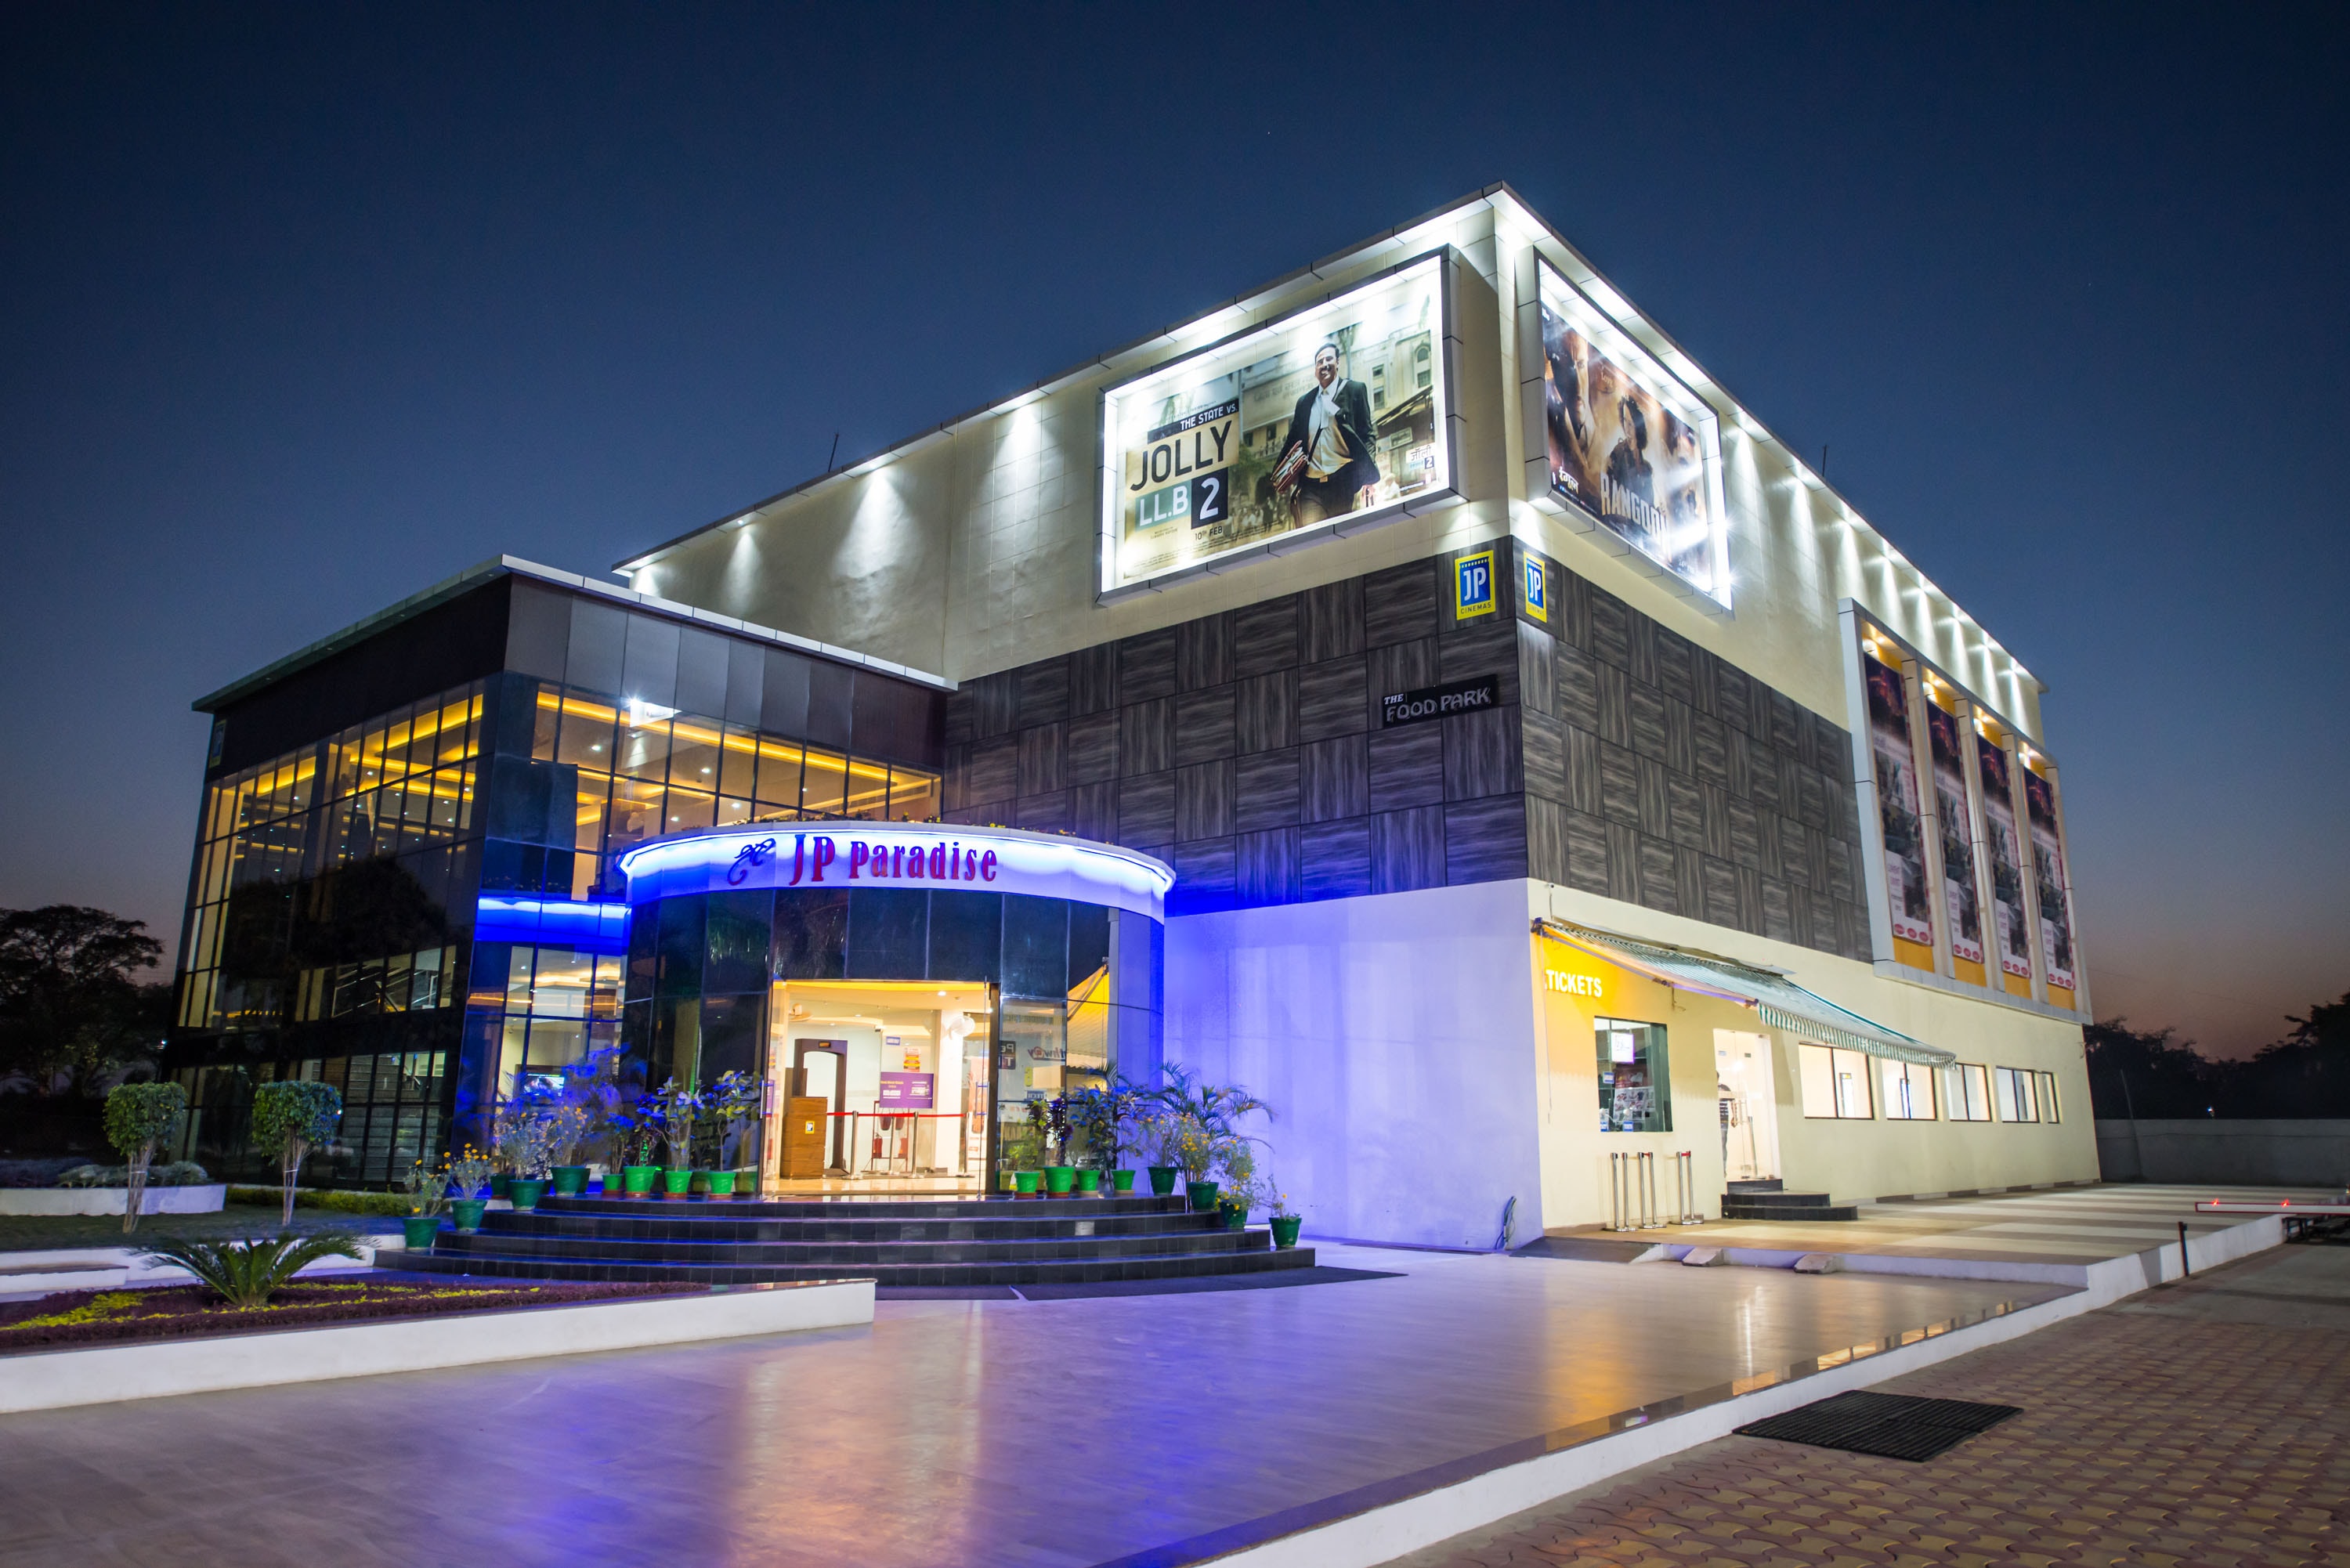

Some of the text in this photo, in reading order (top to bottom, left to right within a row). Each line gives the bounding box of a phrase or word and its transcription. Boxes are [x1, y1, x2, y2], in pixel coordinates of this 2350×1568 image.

[1180, 416, 1196, 431] THE
[1198, 406, 1224, 425] STATE
[1130, 420, 1232, 491] JOLLY
[1427, 457, 1433, 468] 2
[1140, 478, 1220, 526] LL.B 2
[1600, 470, 1672, 563] RANGOON
[1209, 526, 1223, 537] FEB
[1462, 567, 1487, 602] JP
[1528, 567, 1542, 602] JP
[1460, 602, 1491, 615] CINEMAS
[1383, 693, 1405, 705] THE
[1386, 687, 1491, 722] FOOD PARK
[789, 834, 997, 886] JP Paradise
[1546, 969, 1603, 997] TICKETS
